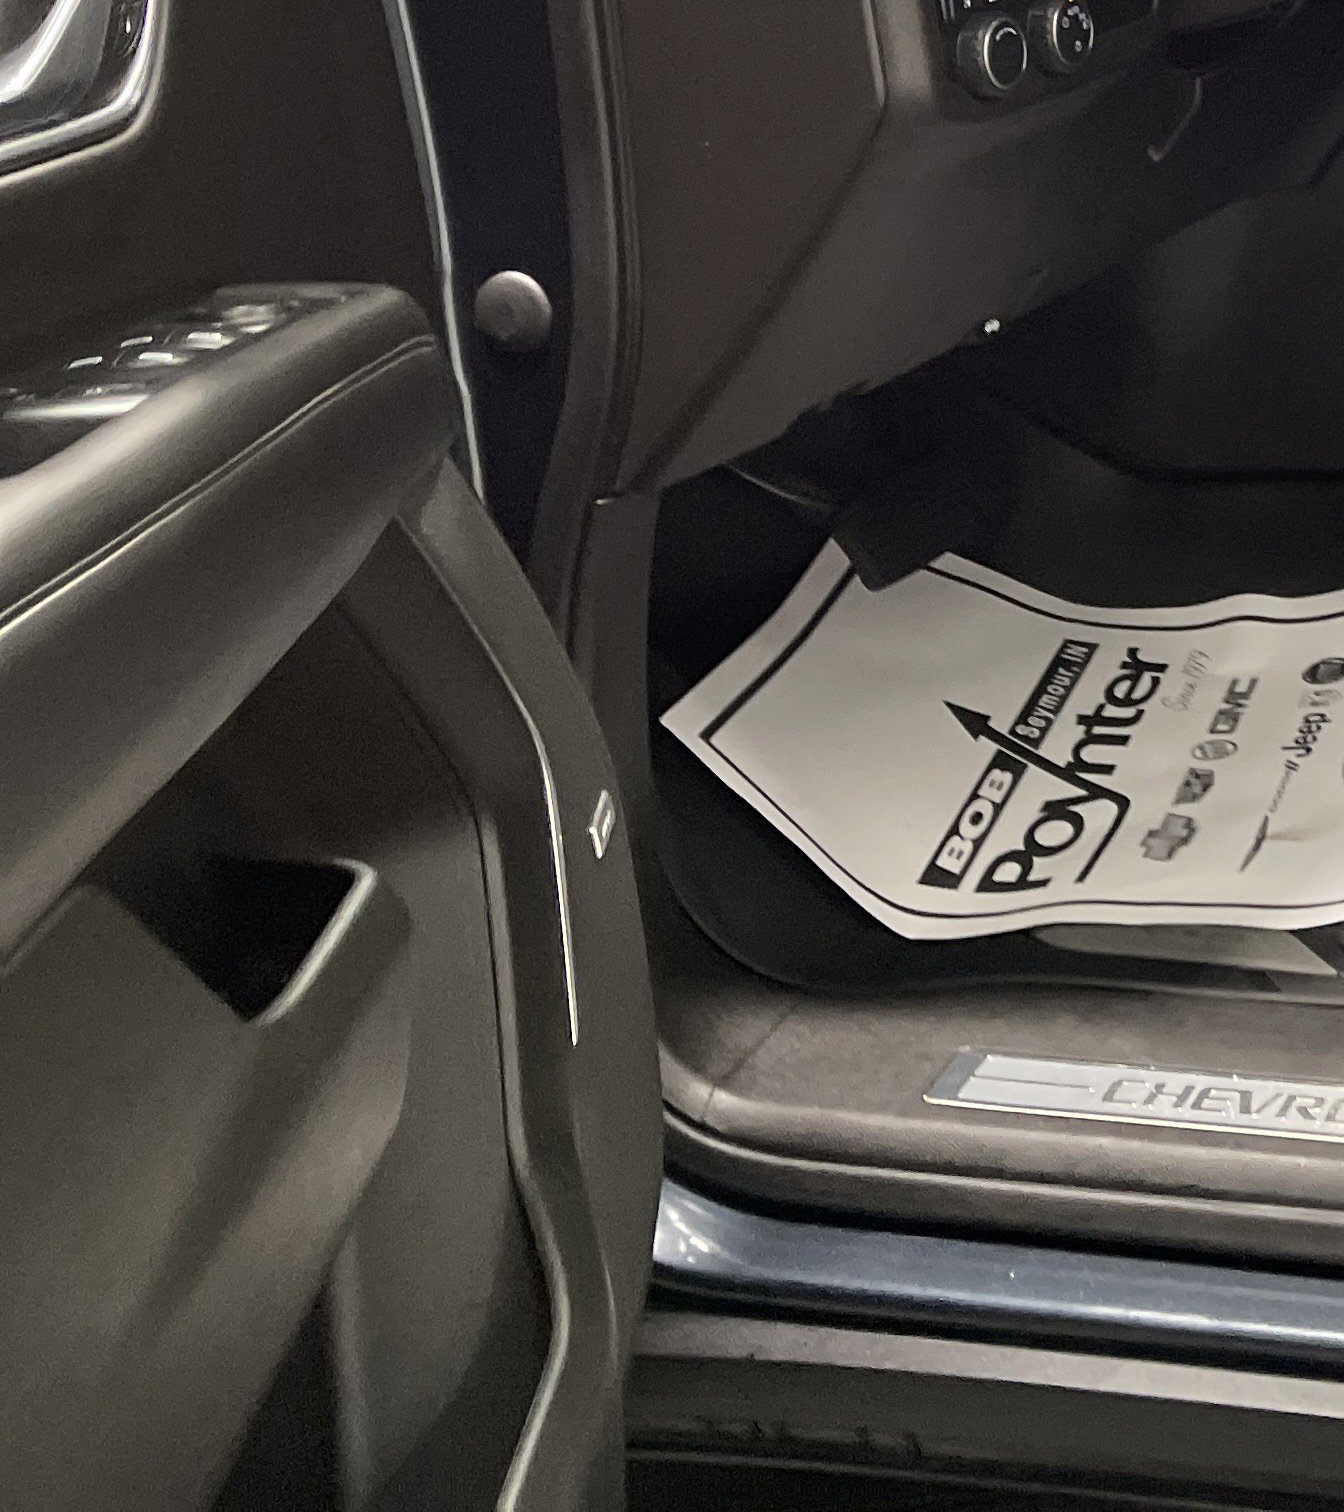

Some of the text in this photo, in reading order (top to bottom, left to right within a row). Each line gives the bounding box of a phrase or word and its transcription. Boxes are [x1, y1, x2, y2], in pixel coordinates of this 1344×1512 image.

[934, 641, 1090, 876] BOB Seymour, IN
[973, 646, 1170, 894] Poynter
[1209, 677, 1260, 735] GMC
[1281, 711, 1333, 758] Jeep
